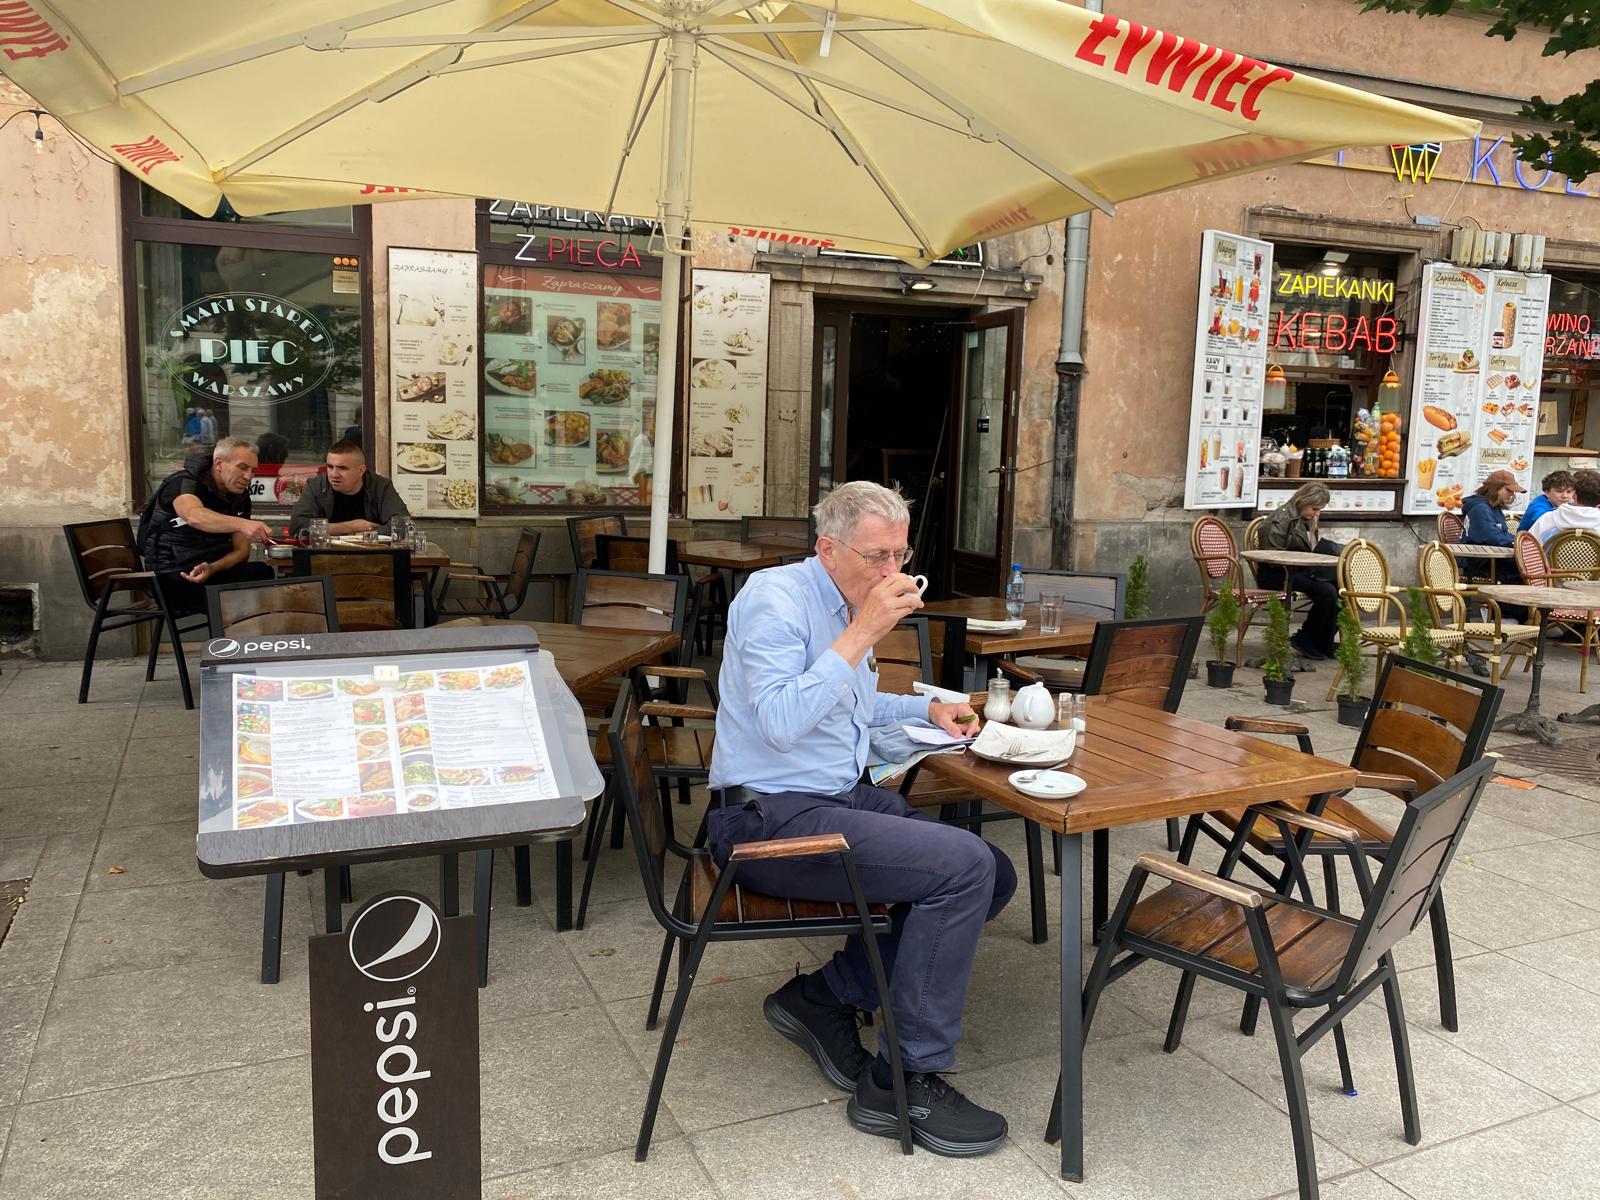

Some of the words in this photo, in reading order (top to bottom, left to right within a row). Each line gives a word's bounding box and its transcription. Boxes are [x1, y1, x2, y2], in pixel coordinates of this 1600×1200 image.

[515, 233, 537, 261] Z
[548, 236, 642, 268] PIECA
[541, 275, 624, 297] Zapraszamy
[1277, 272, 1395, 303] ZAPIEKANKI
[170, 299, 235, 338] SMAKI
[244, 298, 324, 343] STAREJ
[1274, 310, 1397, 354] KEBAB
[1544, 313, 1591, 334] WINO
[200, 338, 299, 366] PIEC
[1545, 336, 1600, 357] RZANE
[192, 372, 304, 398] WARSZAWY
[248, 480, 265, 496] kie
[243, 636, 307, 655] pepsi
[363, 996, 433, 1165] pepsi
